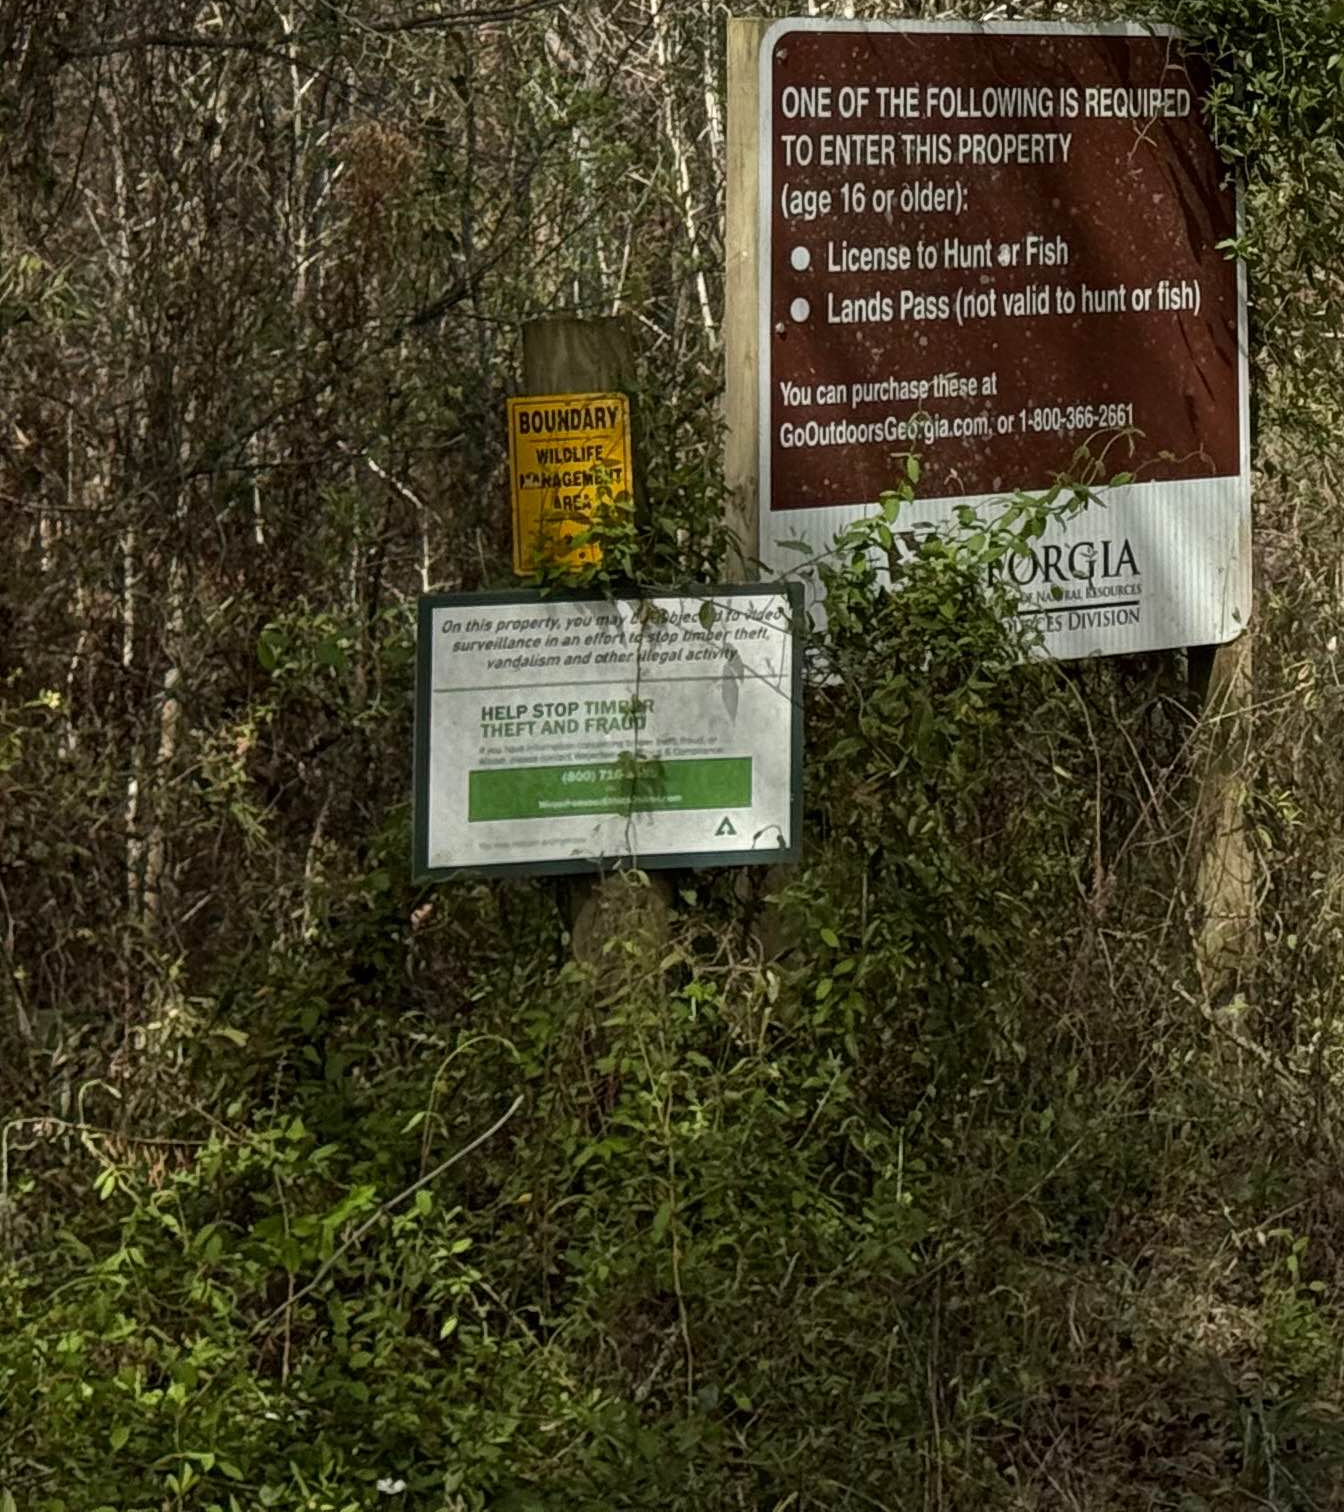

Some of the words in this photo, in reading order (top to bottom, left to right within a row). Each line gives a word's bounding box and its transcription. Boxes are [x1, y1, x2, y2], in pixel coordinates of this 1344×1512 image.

[782, 86, 832, 118] ONE
[839, 86, 870, 118] OF
[876, 86, 920, 118] THE
[927, 87, 1054, 118] FOLLOWING
[1060, 88, 1079, 118] IS
[1085, 88, 1191, 118] REQUIRED
[781, 134, 813, 166] TO
[820, 134, 896, 166] ENTER
[901, 134, 951, 165] THIS
[959, 133, 1072, 164] PROPERTY
[781, 183, 832, 220] (age
[841, 182, 866, 213] 16
[873, 190, 895, 213] or
[901, 181, 968, 215] older):
[828, 241, 911, 272] License
[918, 241, 938, 268] to
[944, 238, 993, 268] Hunt
[997, 243, 1020, 267] or
[1026, 235, 1069, 266] Fish
[828, 291, 893, 323] Lands
[900, 290, 950, 320] Pass
[956, 287, 997, 326] (not
[1003, 285, 1050, 316] valid
[1056, 286, 1076, 314] to
[1082, 284, 1126, 313] hunt
[1132, 287, 1152, 311] or
[1158, 279, 1201, 316] fish)
[780, 381, 811, 406] You
[816, 383, 847, 405] can
[852, 375, 928, 409] purchase
[934, 373, 977, 398] these
[982, 372, 998, 395] at
[518, 405, 619, 434] BOUNDARY
[997, 414, 1015, 434] or
[1019, 403, 1133, 433] 1-800-366-2661
[536, 445, 604, 464] WILDLIFE
[519, 469, 622, 488] MANAGEMET
[553, 494, 593, 510] AREA
[985, 539, 1141, 588] ORGIA
[1037, 587, 1083, 603] NARAL
[442, 620, 461, 633] On
[466, 619, 493, 632] this
[495, 616, 561, 634] property,
[566, 616, 592, 631] you
[596, 614, 625, 627] may
[651, 608, 724, 627] bjecd
[727, 608, 741, 624] to
[1068, 608, 1140, 631] DIVISION
[453, 636, 541, 652] surveillance
[545, 635, 559, 648] in
[562, 637, 580, 647] an
[584, 631, 625, 646] effort
[629, 631, 641, 644] to
[649, 629, 680, 644] stop
[682, 628, 728, 642] timber
[487, 653, 561, 670] vandalism
[564, 652, 592, 666] and
[595, 649, 634, 664] other
[481, 705, 528, 721] HELP
[532, 702, 579, 719] STOP
[584, 699, 655, 715] TIMBR
[480, 721, 537, 738] THEFT
[541, 719, 579, 736] AND
[585, 716, 648, 734] FRAUD
